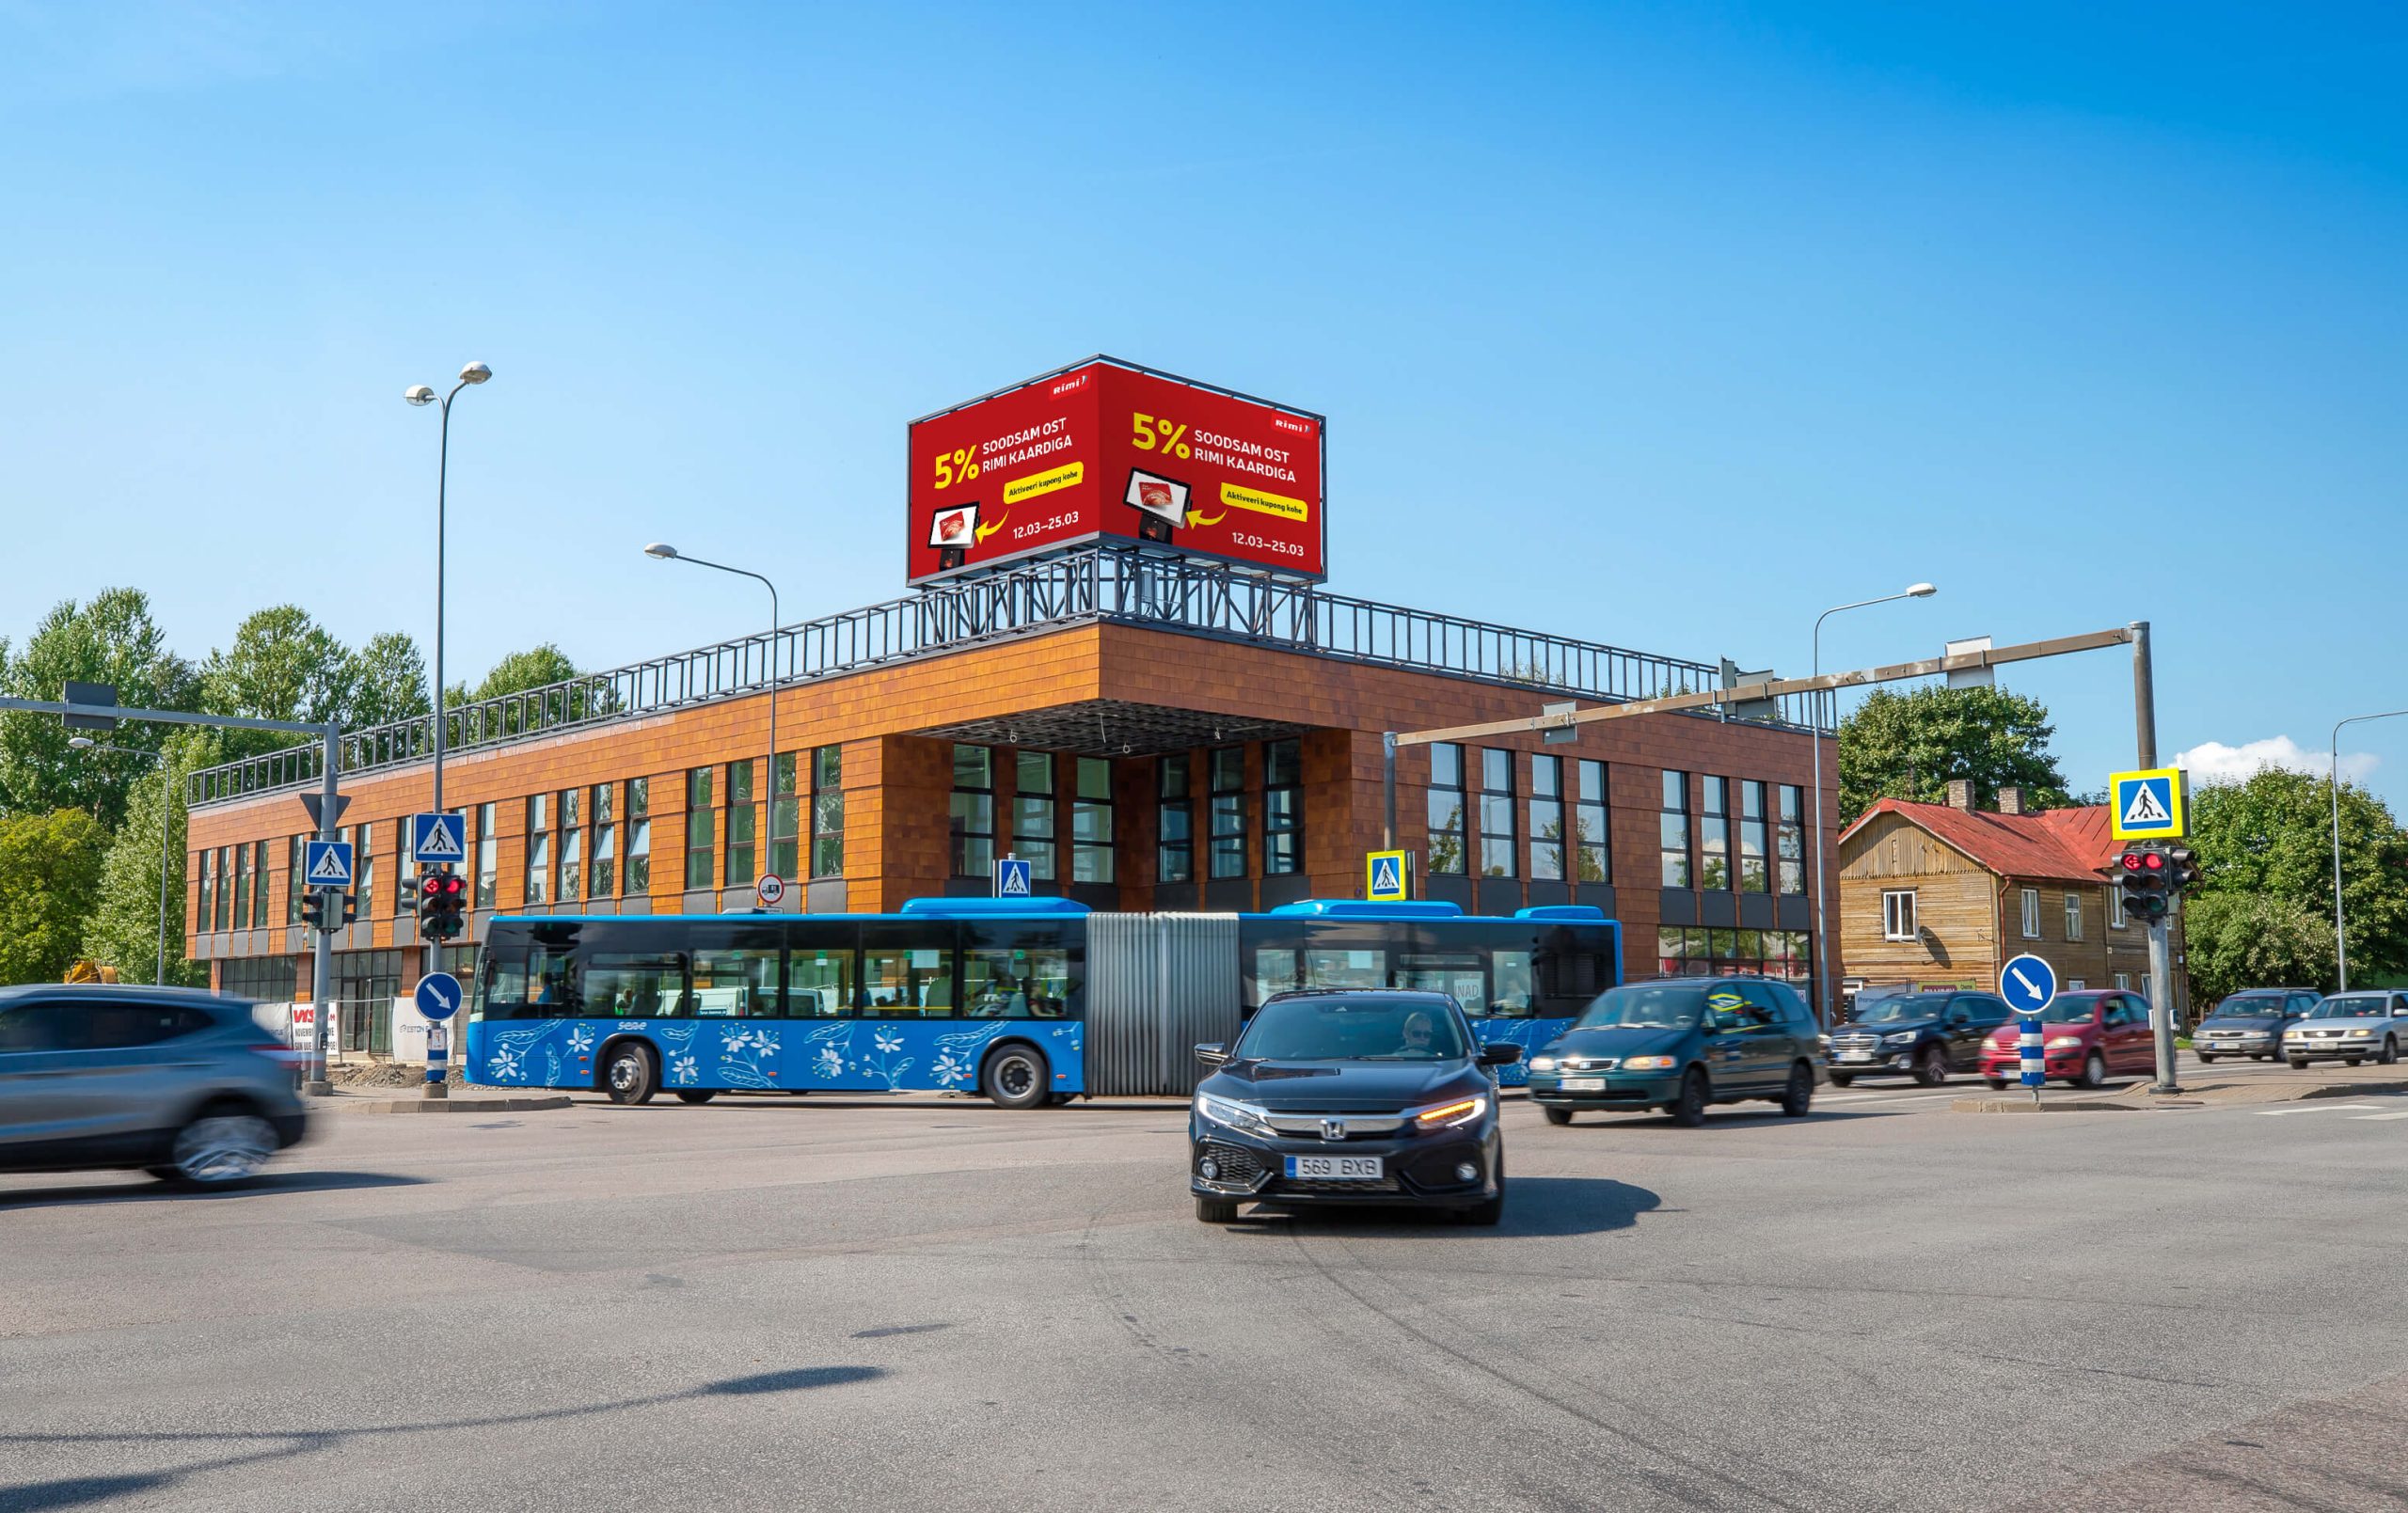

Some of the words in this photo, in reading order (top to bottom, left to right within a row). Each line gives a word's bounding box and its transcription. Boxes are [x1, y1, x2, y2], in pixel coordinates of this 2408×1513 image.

[982, 426, 1040, 455] SOODSAM
[1042, 417, 1067, 435] OST
[982, 455, 1006, 473] RIMI
[1008, 434, 1073, 465] KAARDIGA
[1132, 412, 1191, 460] 5%
[1195, 430, 1261, 458] SOODSAM
[1264, 448, 1290, 464] OST
[934, 445, 980, 490] 5%
[1008, 481, 1038, 496] Aktiveeri
[1038, 476, 1062, 489] kupong
[1062, 470, 1078, 481] kohe
[1195, 448, 1224, 465] RIMI
[1227, 455, 1296, 483] KAARDIGA
[1227, 491, 1259, 505] Aktiveeri
[1260, 498, 1286, 512] kupong
[1286, 503, 1303, 514] kohe
[1302, 1158, 1331, 1174] 569
[1340, 1158, 1377, 1175] BXB
